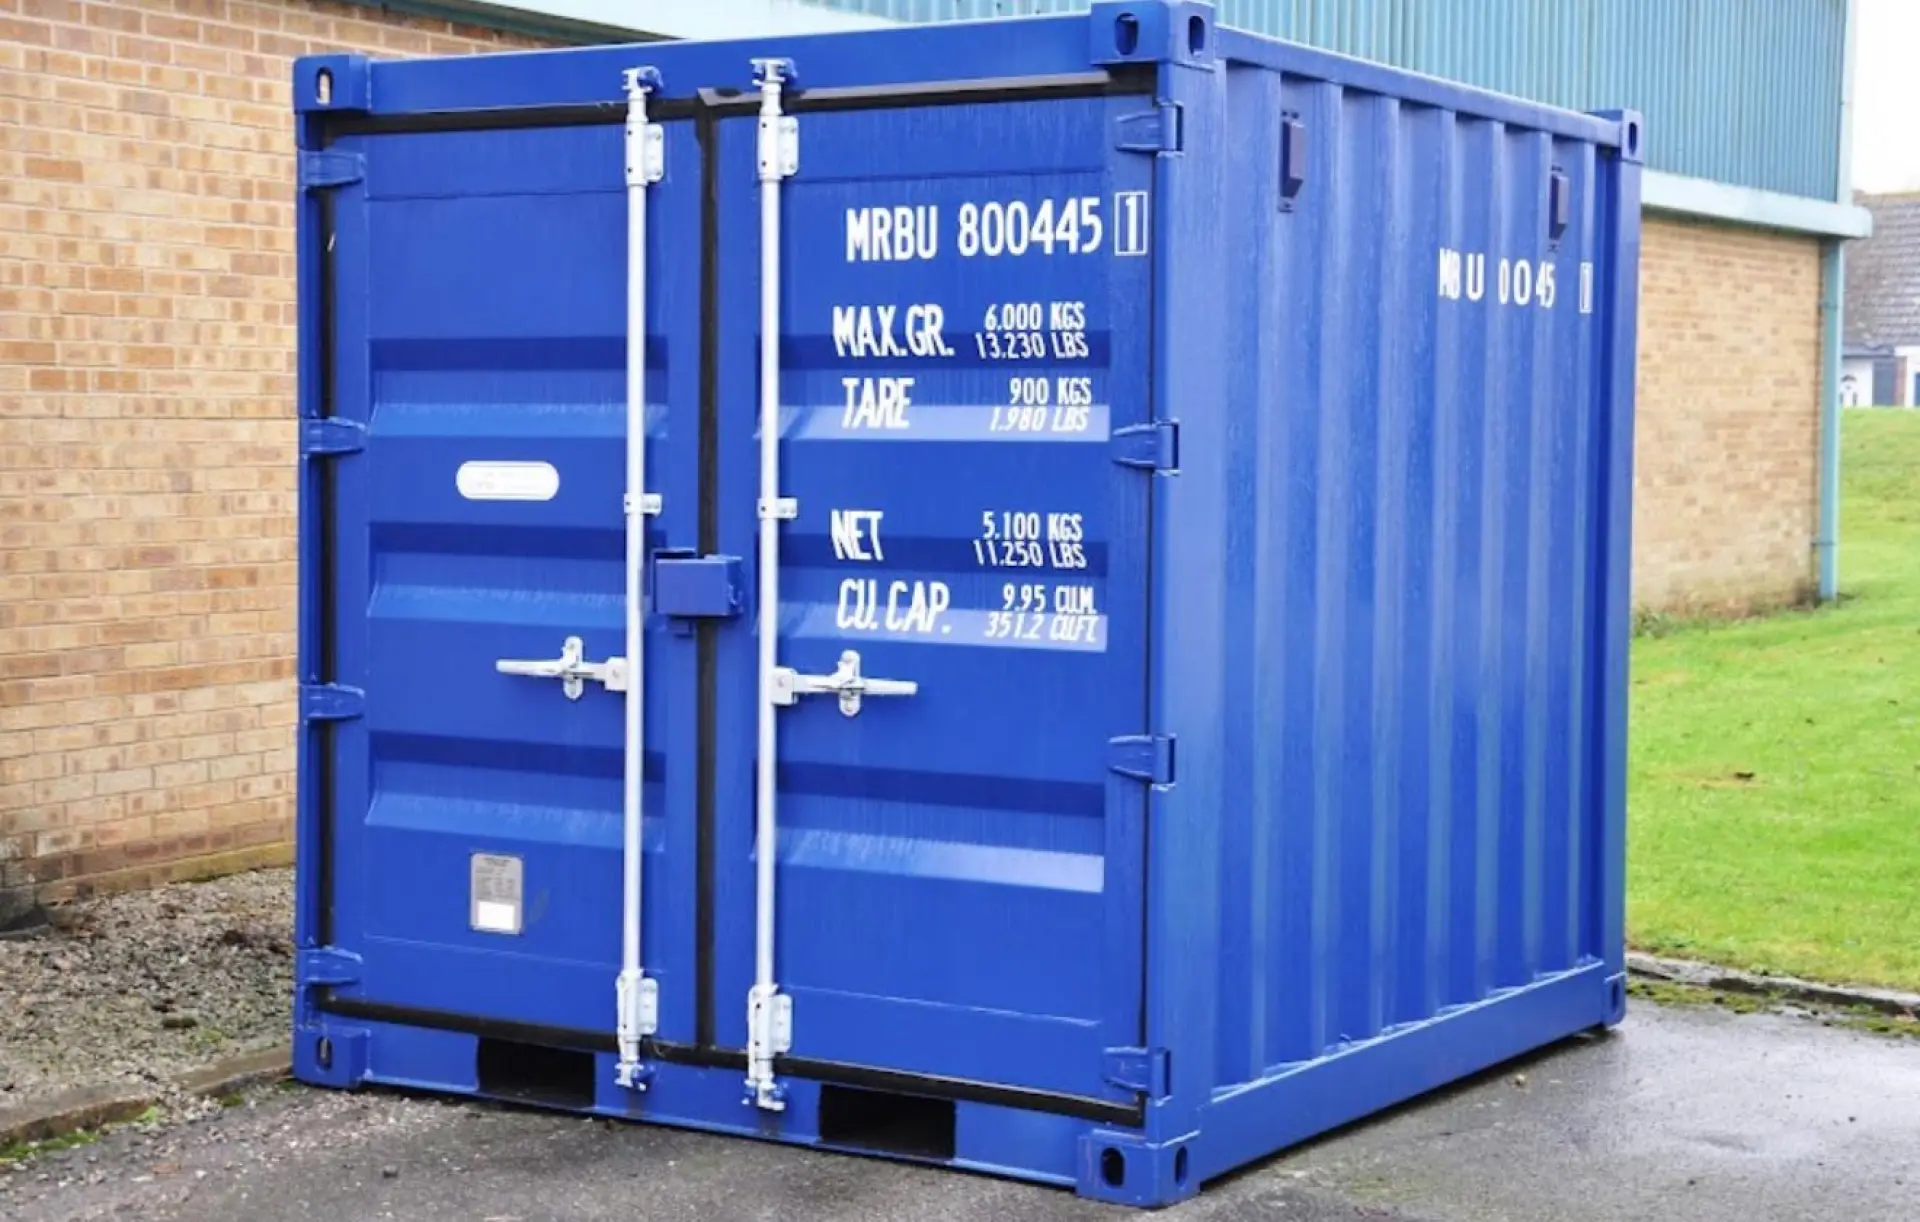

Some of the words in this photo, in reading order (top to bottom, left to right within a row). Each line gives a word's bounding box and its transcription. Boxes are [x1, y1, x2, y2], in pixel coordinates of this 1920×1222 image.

[846, 205, 938, 262] MRBU
[957, 198, 1103, 256] 800445
[985, 303, 1042, 331] 6.000
[1050, 301, 1085, 331] KGS
[975, 331, 1046, 359] 13.230
[1051, 331, 1089, 358] LBS
[841, 378, 915, 429] TARE
[1010, 377, 1050, 405] 900
[1058, 377, 1092, 405] KGS
[989, 406, 1047, 432] 1.980
[1051, 406, 1090, 432] LBS
[831, 510, 884, 561] NET
[982, 511, 1041, 541] 5.100
[1047, 512, 1083, 542] KGS
[973, 540, 1044, 567] 11.250
[1048, 541, 1088, 569] LBS
[1003, 583, 1046, 613] 9.95
[984, 611, 1045, 639] 351.2
